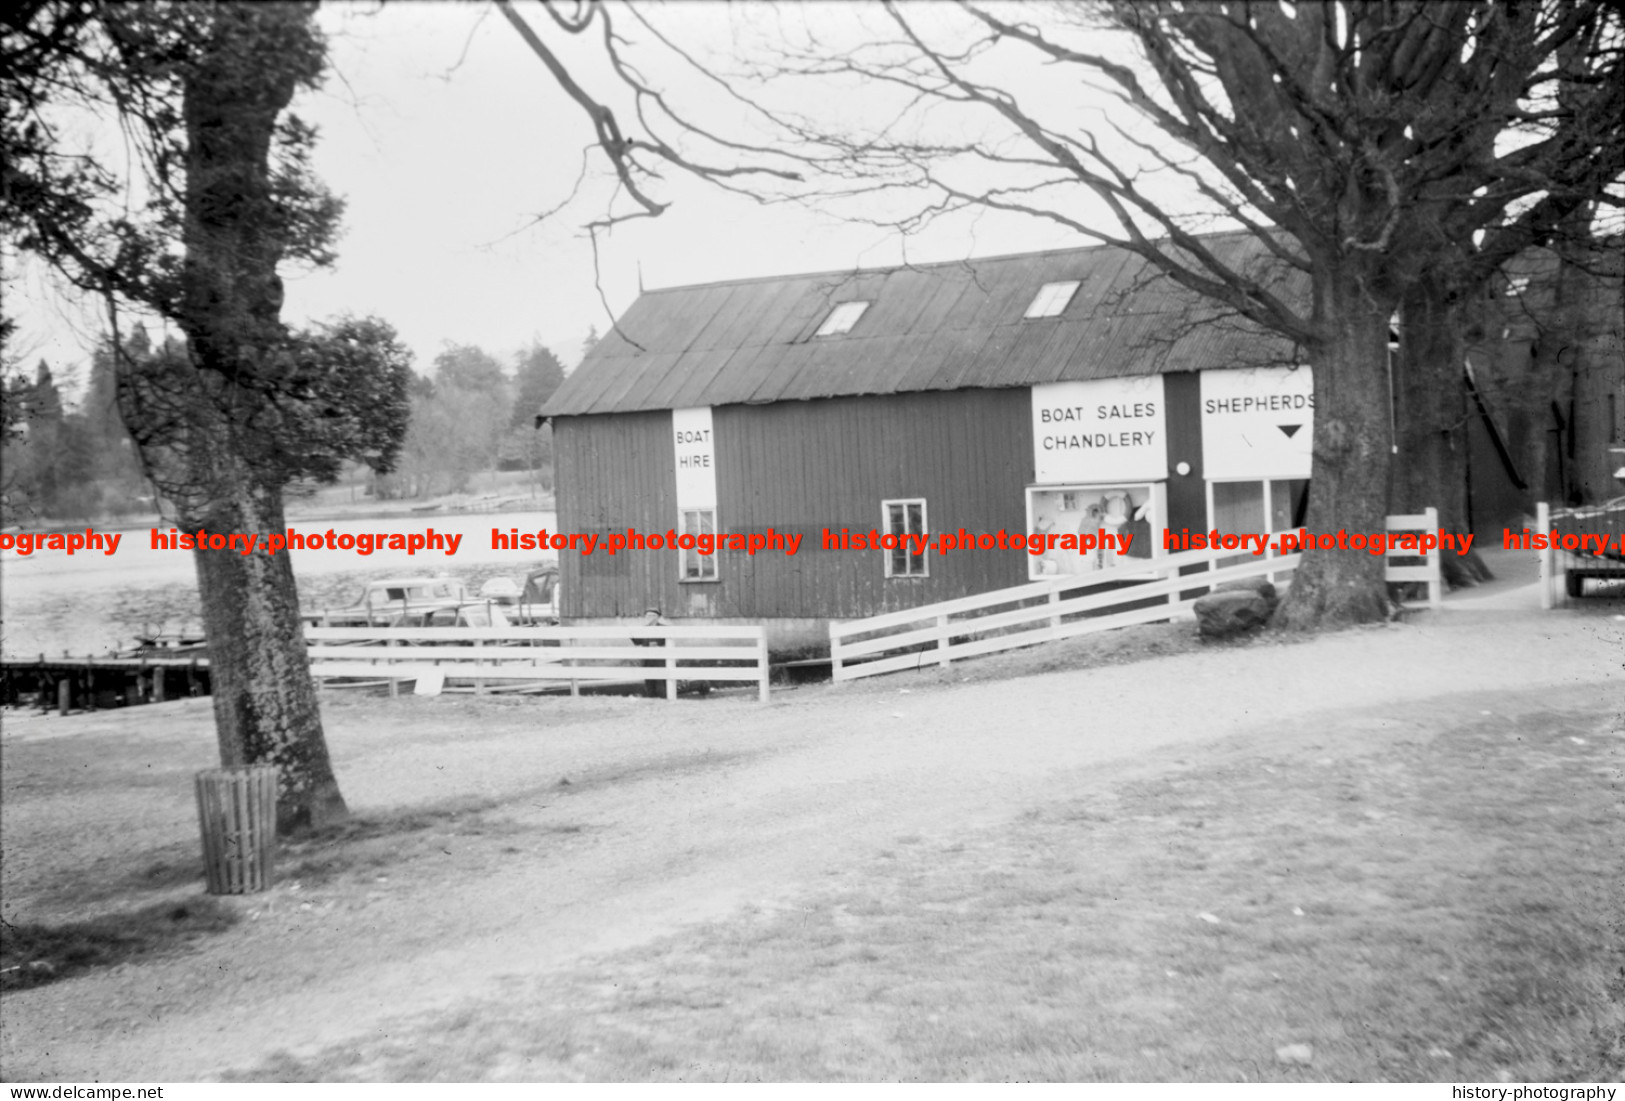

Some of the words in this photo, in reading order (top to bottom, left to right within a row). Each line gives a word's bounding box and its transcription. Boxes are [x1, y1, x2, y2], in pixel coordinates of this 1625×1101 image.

[1041, 406, 1083, 423] BOAT
[1097, 402, 1156, 420] SALES
[1205, 393, 1316, 414] SHEPHERDS
[676, 429, 711, 444] BOAT
[1042, 431, 1155, 451] CHANDLERY
[679, 454, 711, 468] HIRE
